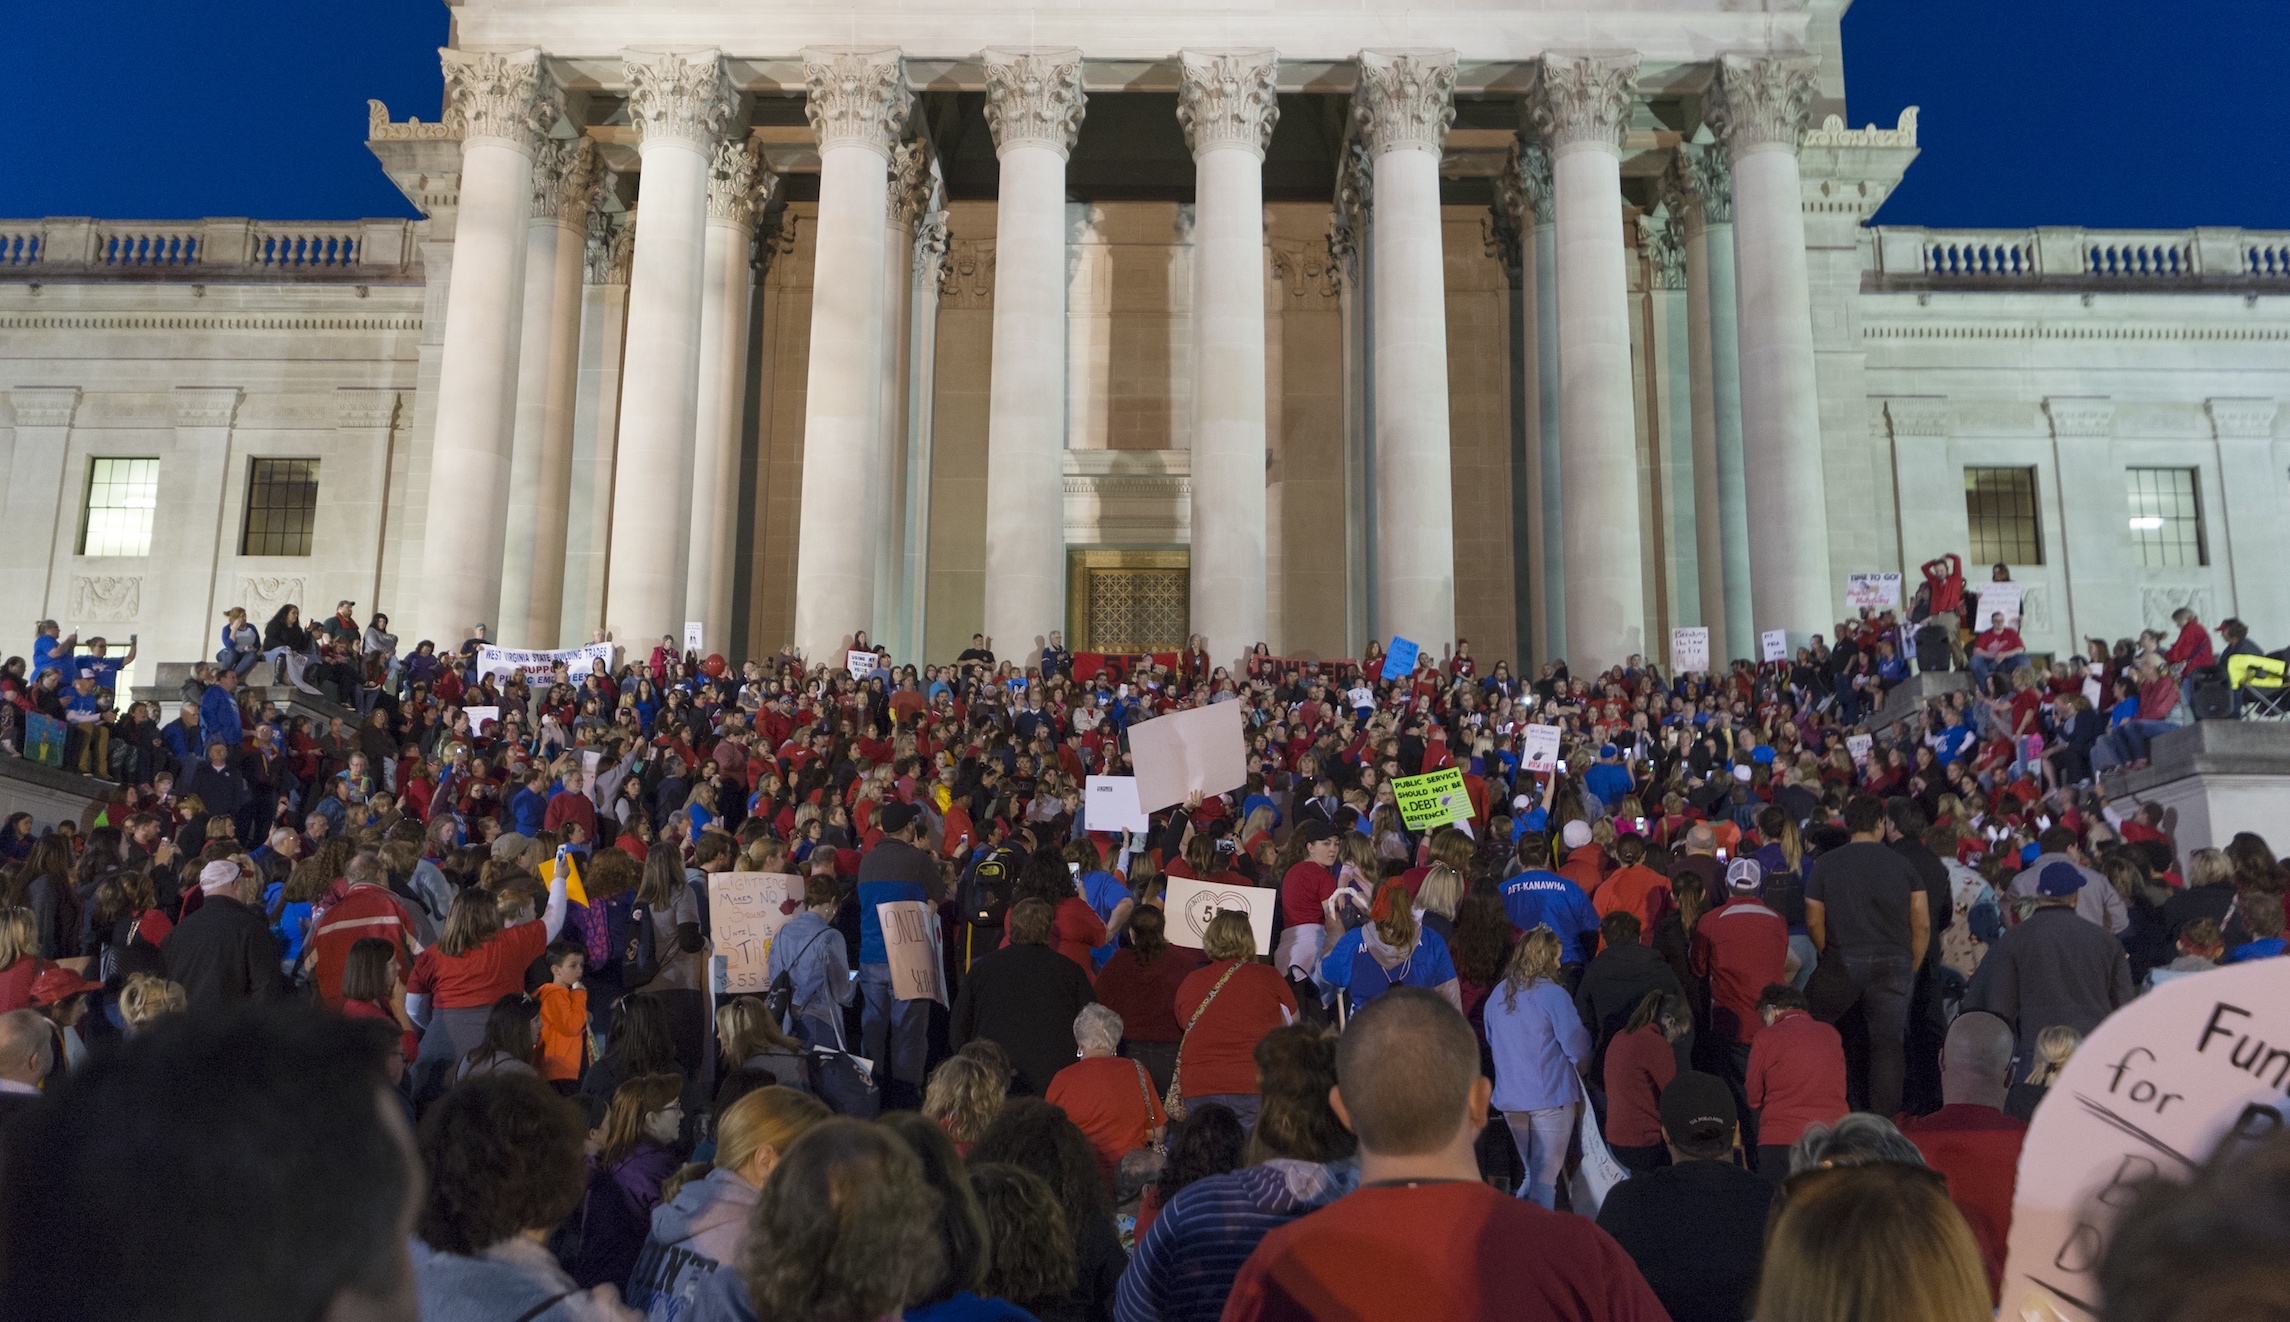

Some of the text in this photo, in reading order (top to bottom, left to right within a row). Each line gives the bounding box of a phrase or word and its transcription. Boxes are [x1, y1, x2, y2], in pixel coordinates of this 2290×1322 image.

[1675, 630, 1706, 639] Breaking
[485, 647, 608, 663] WEST VIRGINIA STATE BUILDING TRADES
[1395, 771, 1459, 789] PUBLIC SERVICE
[1397, 781, 1462, 799] SHOULD NOT BE
[1409, 798, 1437, 812] DEBT
[1405, 808, 1449, 822] SENTENCE!
[1507, 881, 1566, 895] AFT-KANAWHA
[760, 890, 777, 904] NO
[1188, 894, 1212, 908] UNITED
[737, 973, 757, 987] 55
[2196, 1001, 2290, 1098] Fun
[2107, 1047, 2184, 1115] for
